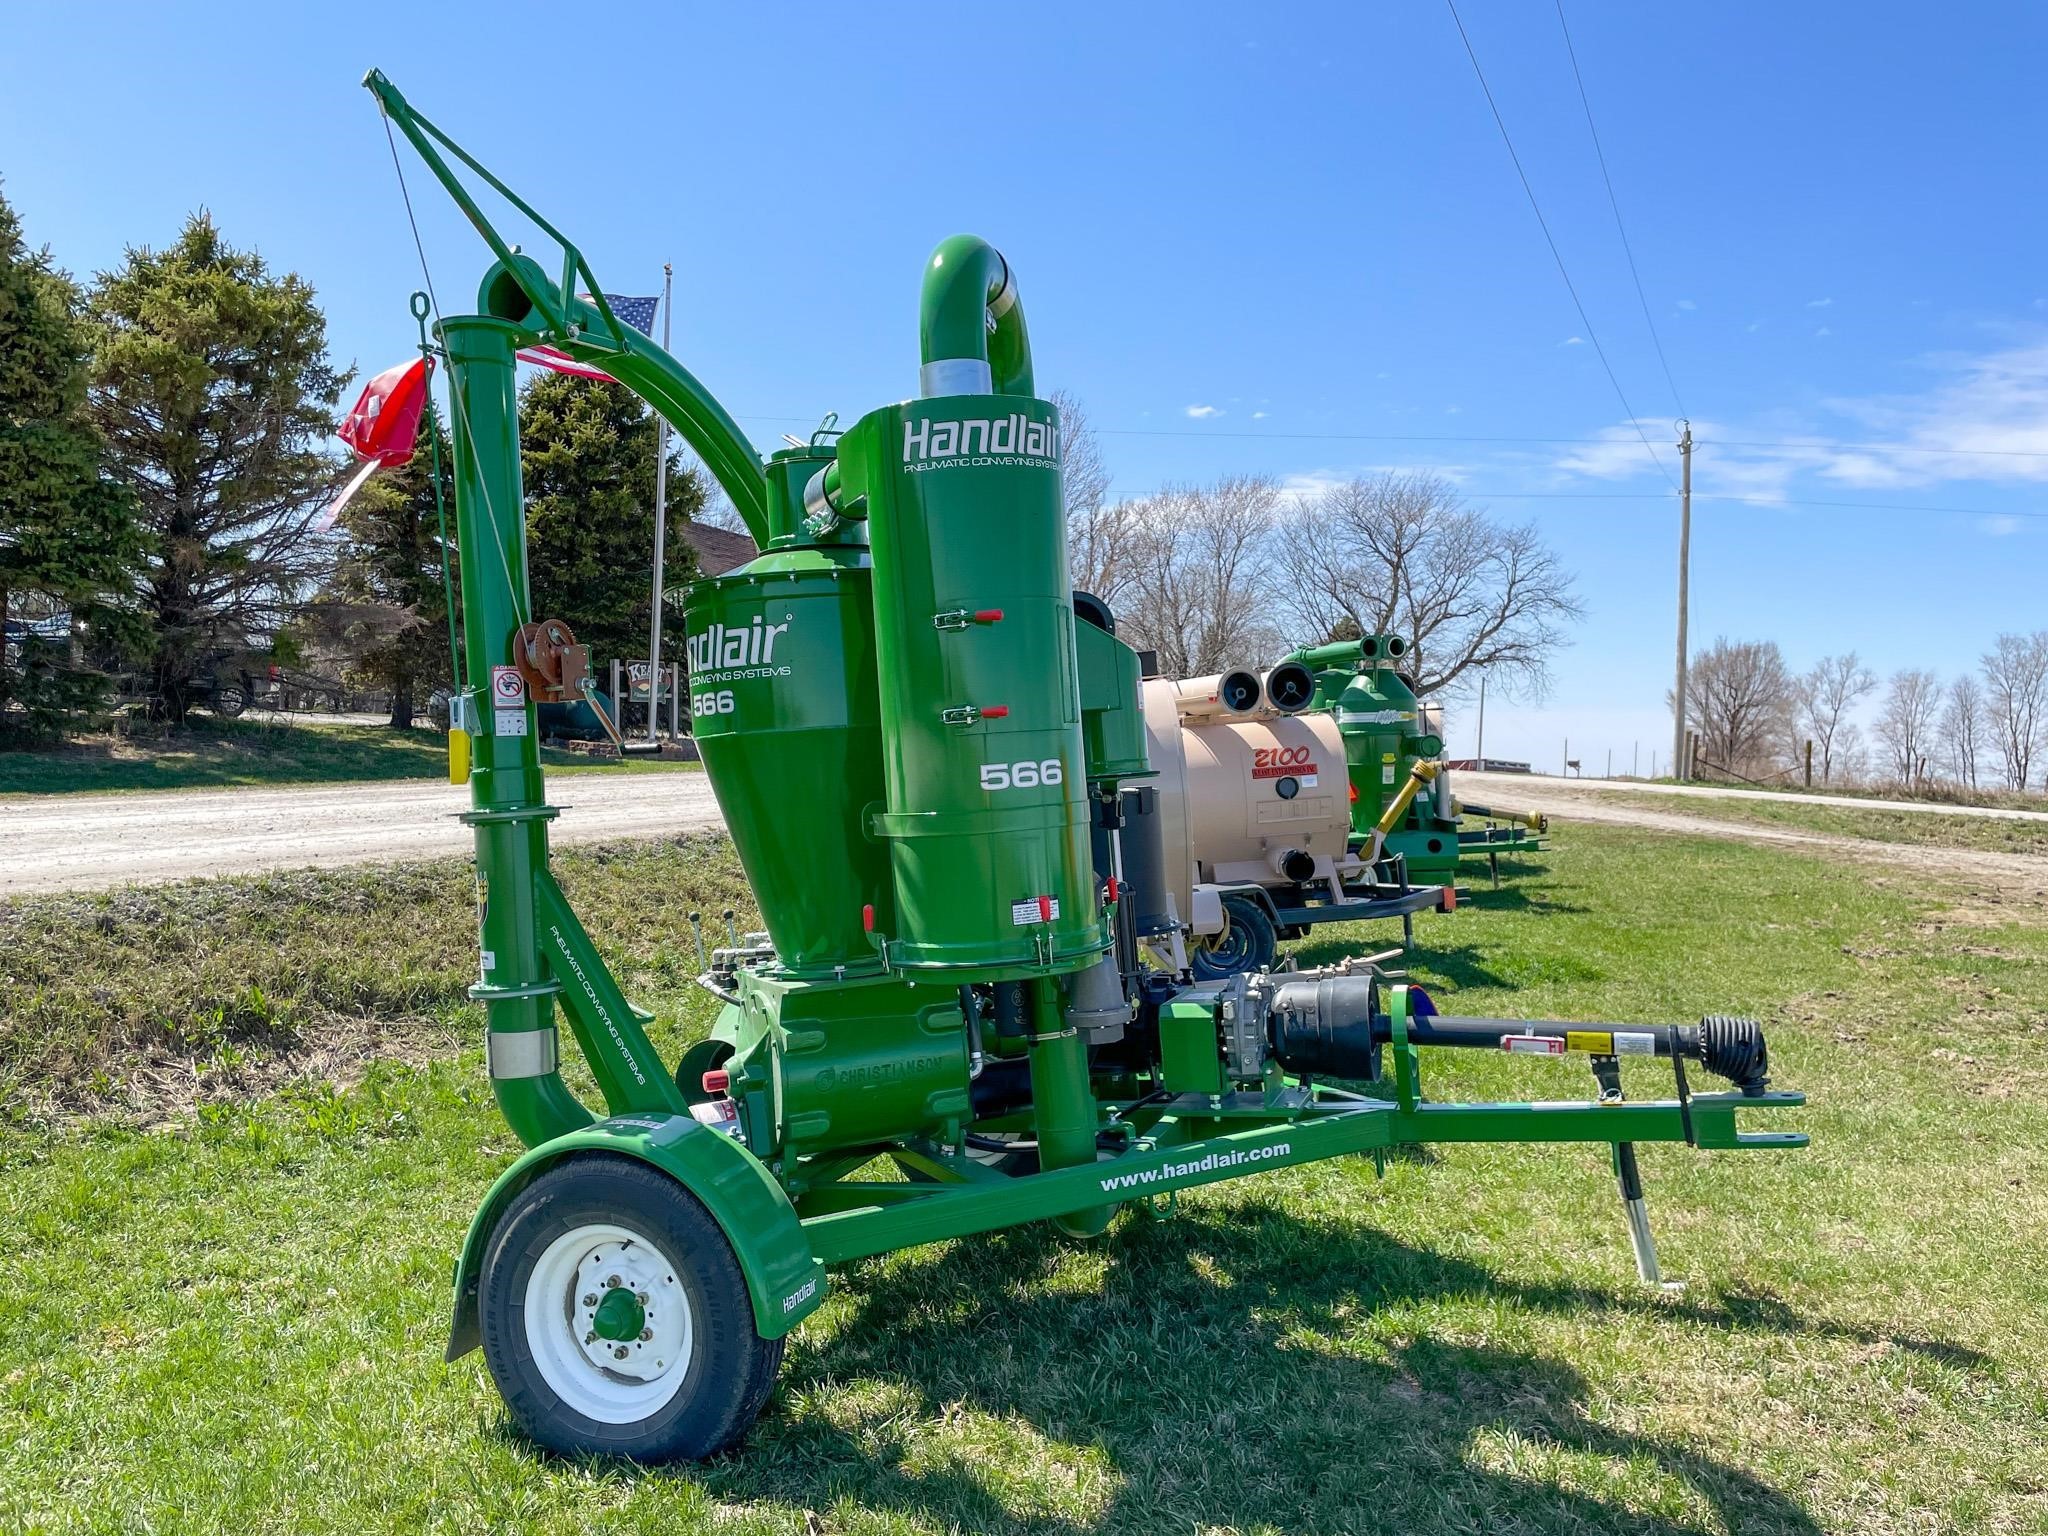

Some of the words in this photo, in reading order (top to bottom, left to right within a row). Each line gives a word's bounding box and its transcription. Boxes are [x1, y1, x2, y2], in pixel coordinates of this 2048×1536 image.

[903, 413, 1058, 462] Handlair
[904, 457, 970, 474] PNEUMATIC
[971, 456, 1035, 467] CONVEYING
[688, 615, 788, 673] ndlair
[628, 663, 665, 682] KEAT
[733, 666, 791, 680] SYSTEMS
[693, 690, 735, 717] 566
[1254, 745, 1310, 767] 2100
[980, 759, 1063, 791] 566
[550, 925, 586, 982] PNEUMATIC
[582, 979, 619, 1039] CONVEYING
[615, 1036, 646, 1086] SYSTEMS
[1100, 1142, 1291, 1192] www.handlair.com
[782, 1278, 817, 1314] Handlair
